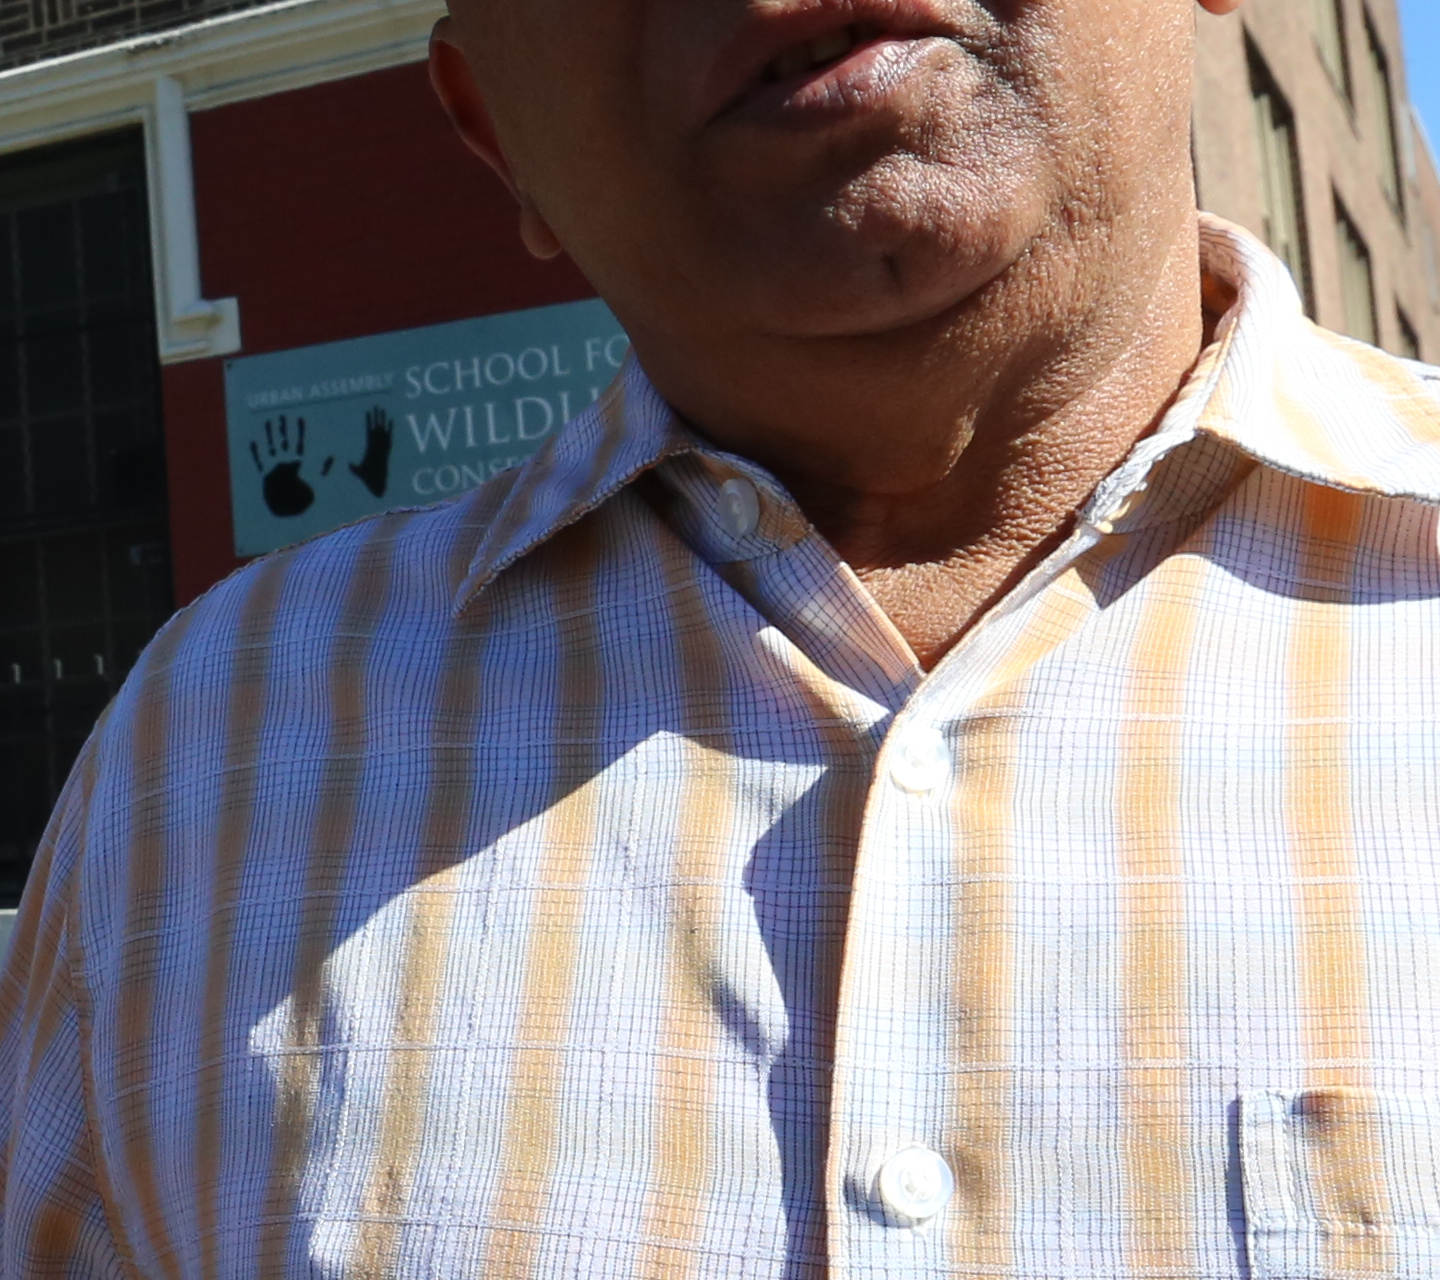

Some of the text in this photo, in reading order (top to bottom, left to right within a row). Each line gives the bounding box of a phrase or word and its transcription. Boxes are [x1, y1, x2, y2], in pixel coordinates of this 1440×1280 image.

[246, 371, 394, 409] URBAN ASSEMBLY
[405, 345, 570, 399] SCHOOL
